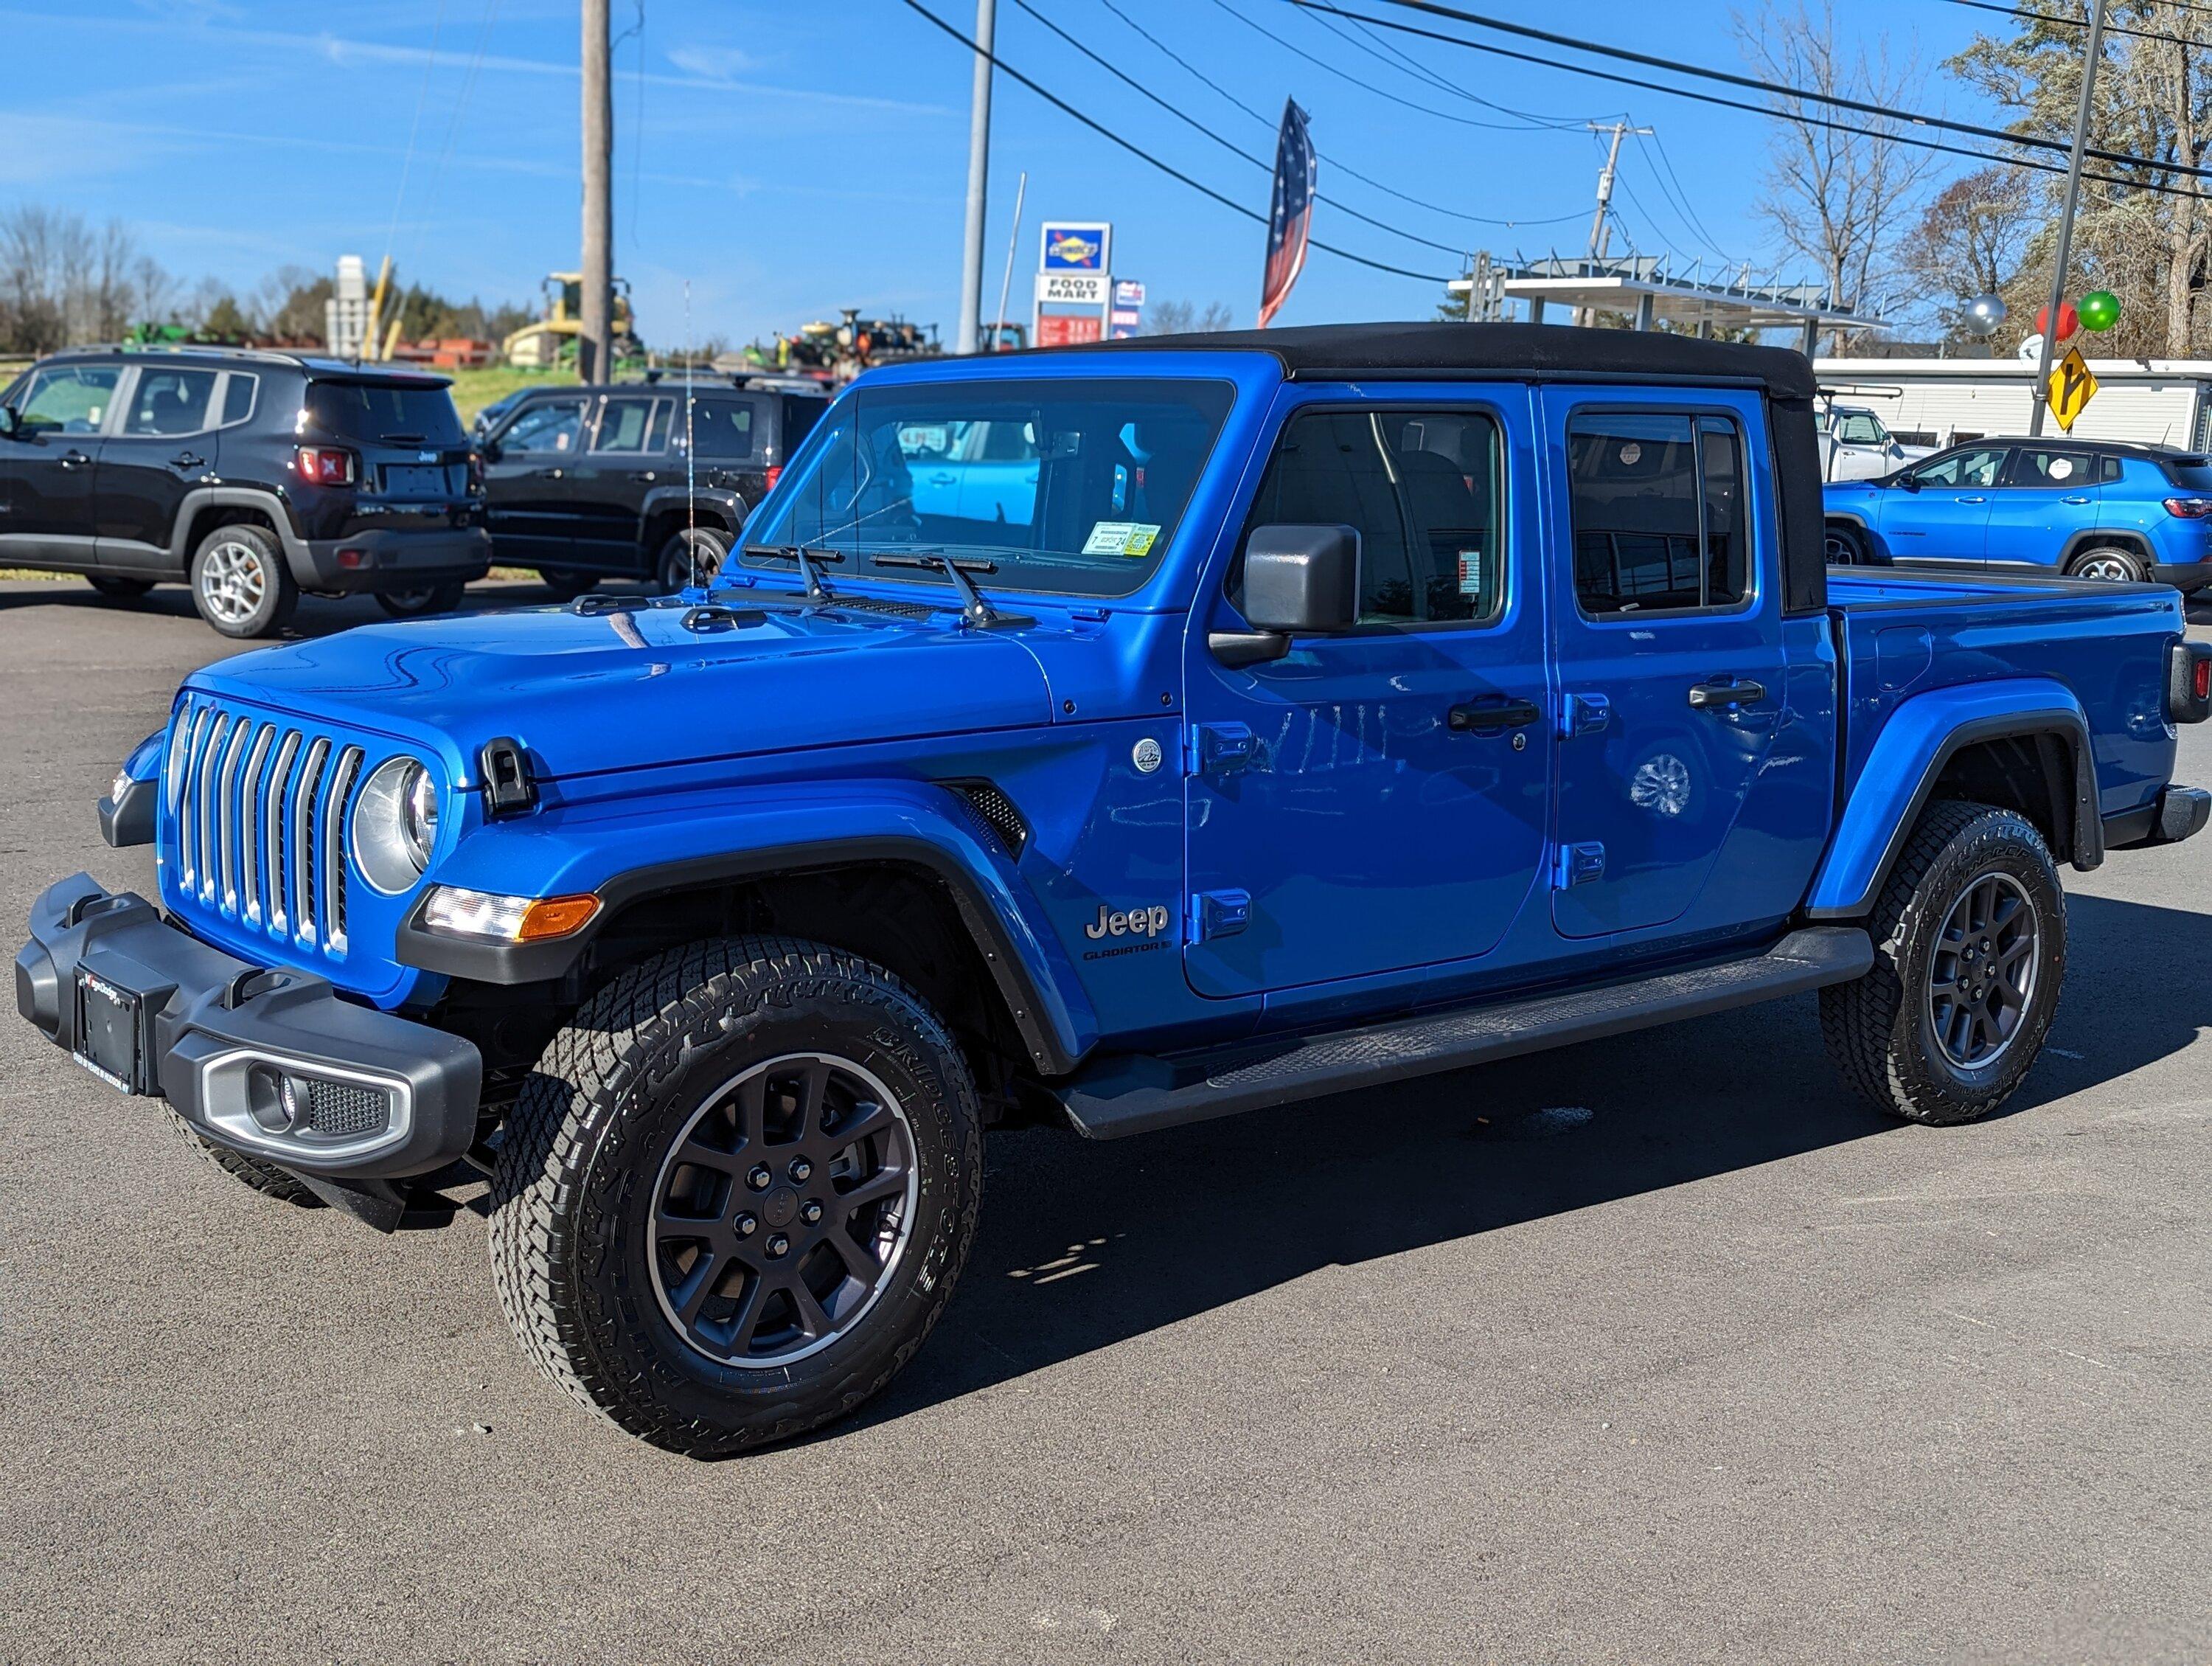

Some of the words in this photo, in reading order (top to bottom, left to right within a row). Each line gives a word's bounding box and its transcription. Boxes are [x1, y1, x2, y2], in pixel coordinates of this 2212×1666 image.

[1050, 279, 1097, 288] FOOD
[1048, 289, 1098, 299] MART
[1086, 905, 1168, 939] Jeep
[1083, 942, 1159, 960] GLADIATOR
